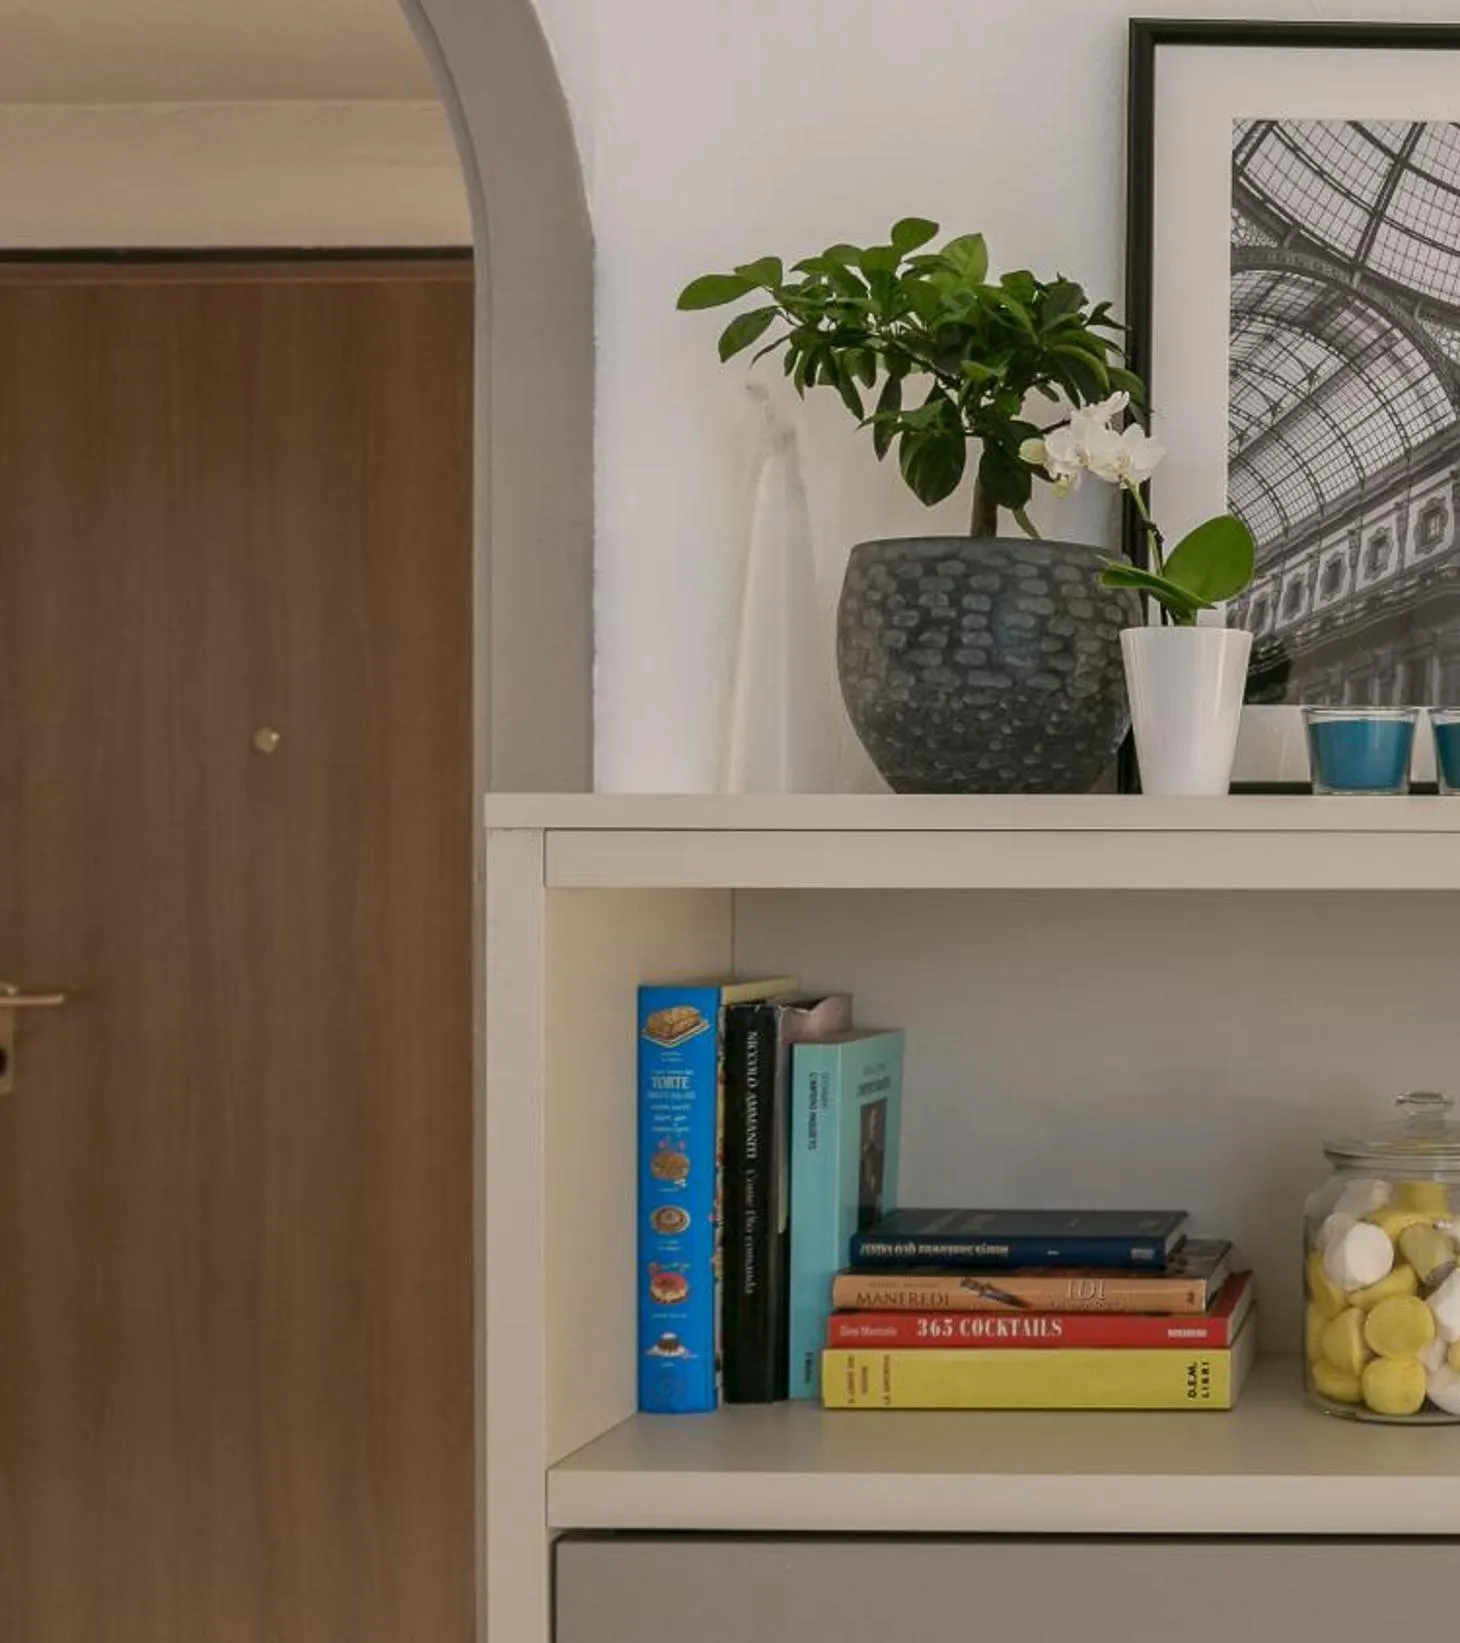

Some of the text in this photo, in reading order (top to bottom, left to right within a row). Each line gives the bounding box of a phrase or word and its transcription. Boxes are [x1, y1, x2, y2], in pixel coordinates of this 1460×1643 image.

[855, 1291, 950, 1307] MANFREDI
[917, 1317, 953, 1337] 365
[959, 1317, 1063, 1337] COCKTAILS
[1201, 1361, 1210, 1398] LIBRI
